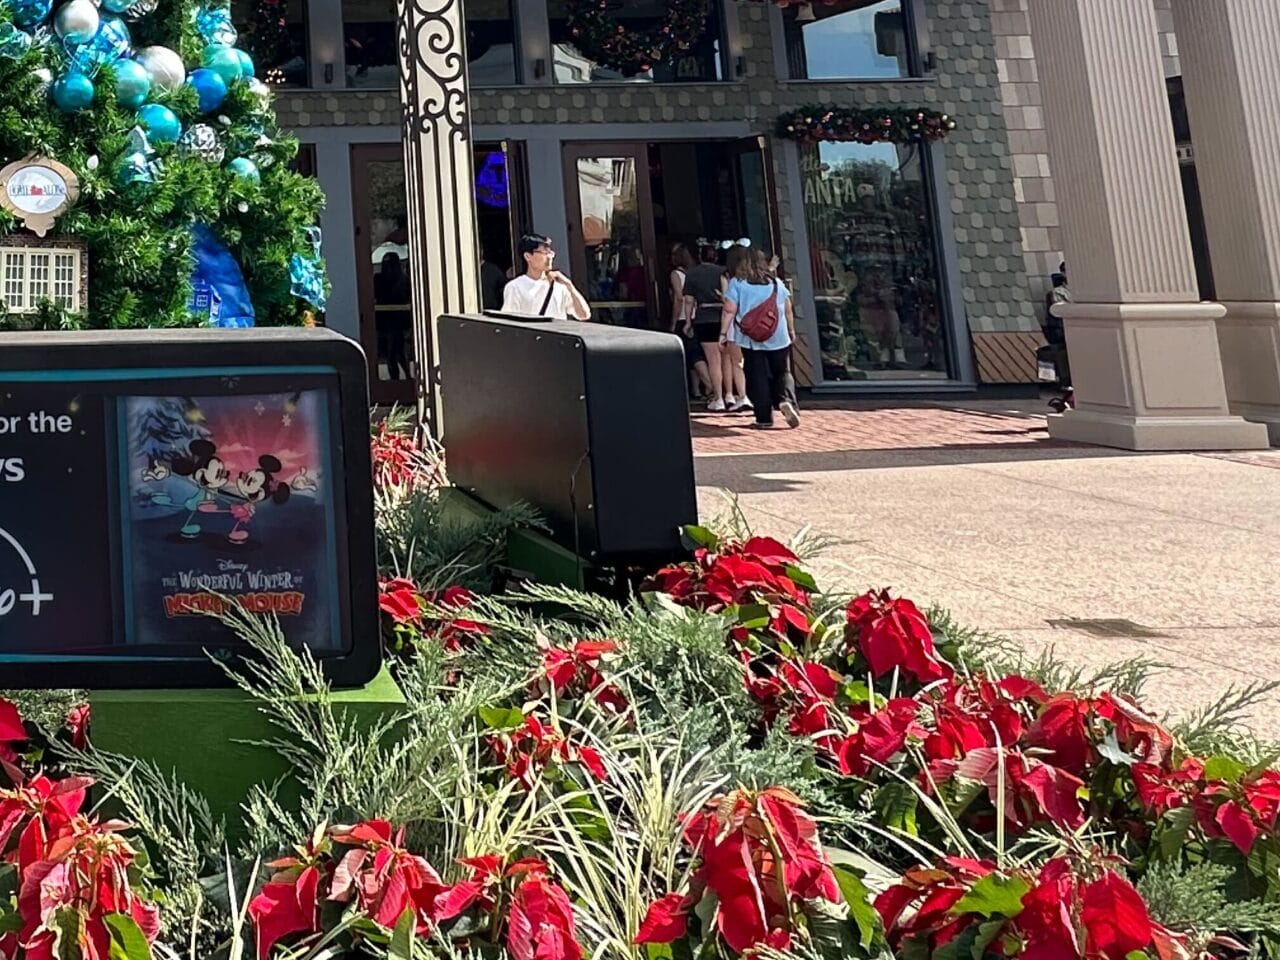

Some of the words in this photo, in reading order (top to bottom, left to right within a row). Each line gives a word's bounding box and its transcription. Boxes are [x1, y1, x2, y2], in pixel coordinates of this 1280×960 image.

[28, 410, 72, 433] the
[216, 558, 249, 572] Disney
[178, 570, 243, 590] WONDERFUL
[246, 570, 294, 590] WINTER
